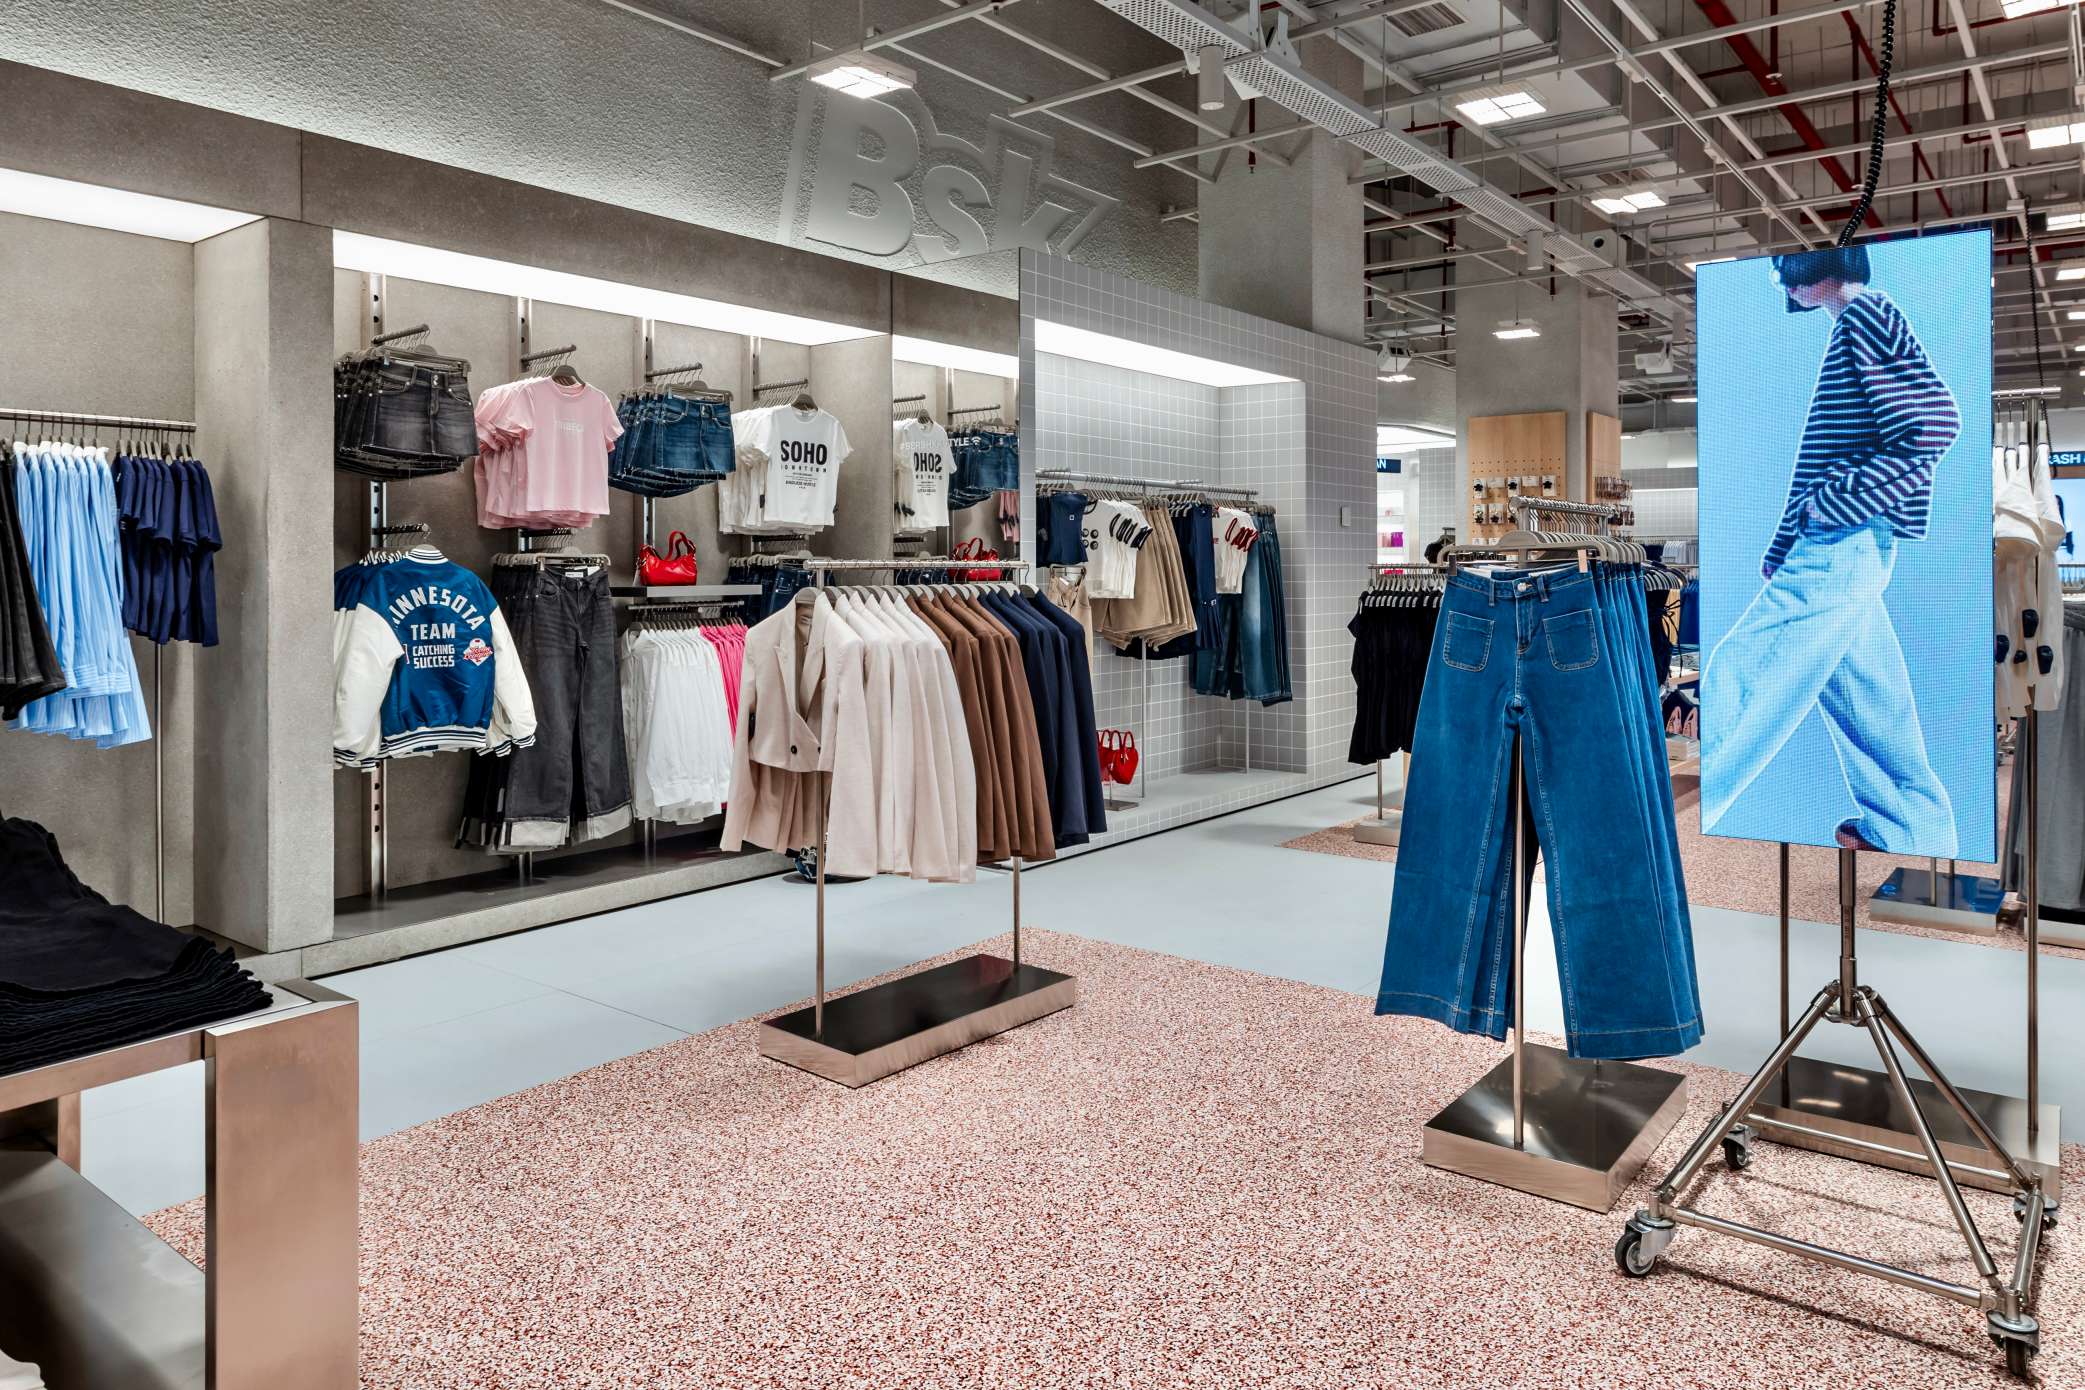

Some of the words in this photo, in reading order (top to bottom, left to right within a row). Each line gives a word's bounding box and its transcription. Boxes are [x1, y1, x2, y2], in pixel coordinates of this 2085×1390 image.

[780, 440, 828, 465] SOHO
[410, 623, 456, 640] TEAM
[412, 643, 456, 657] CATCHING
[413, 655, 456, 669] SUCCESS
